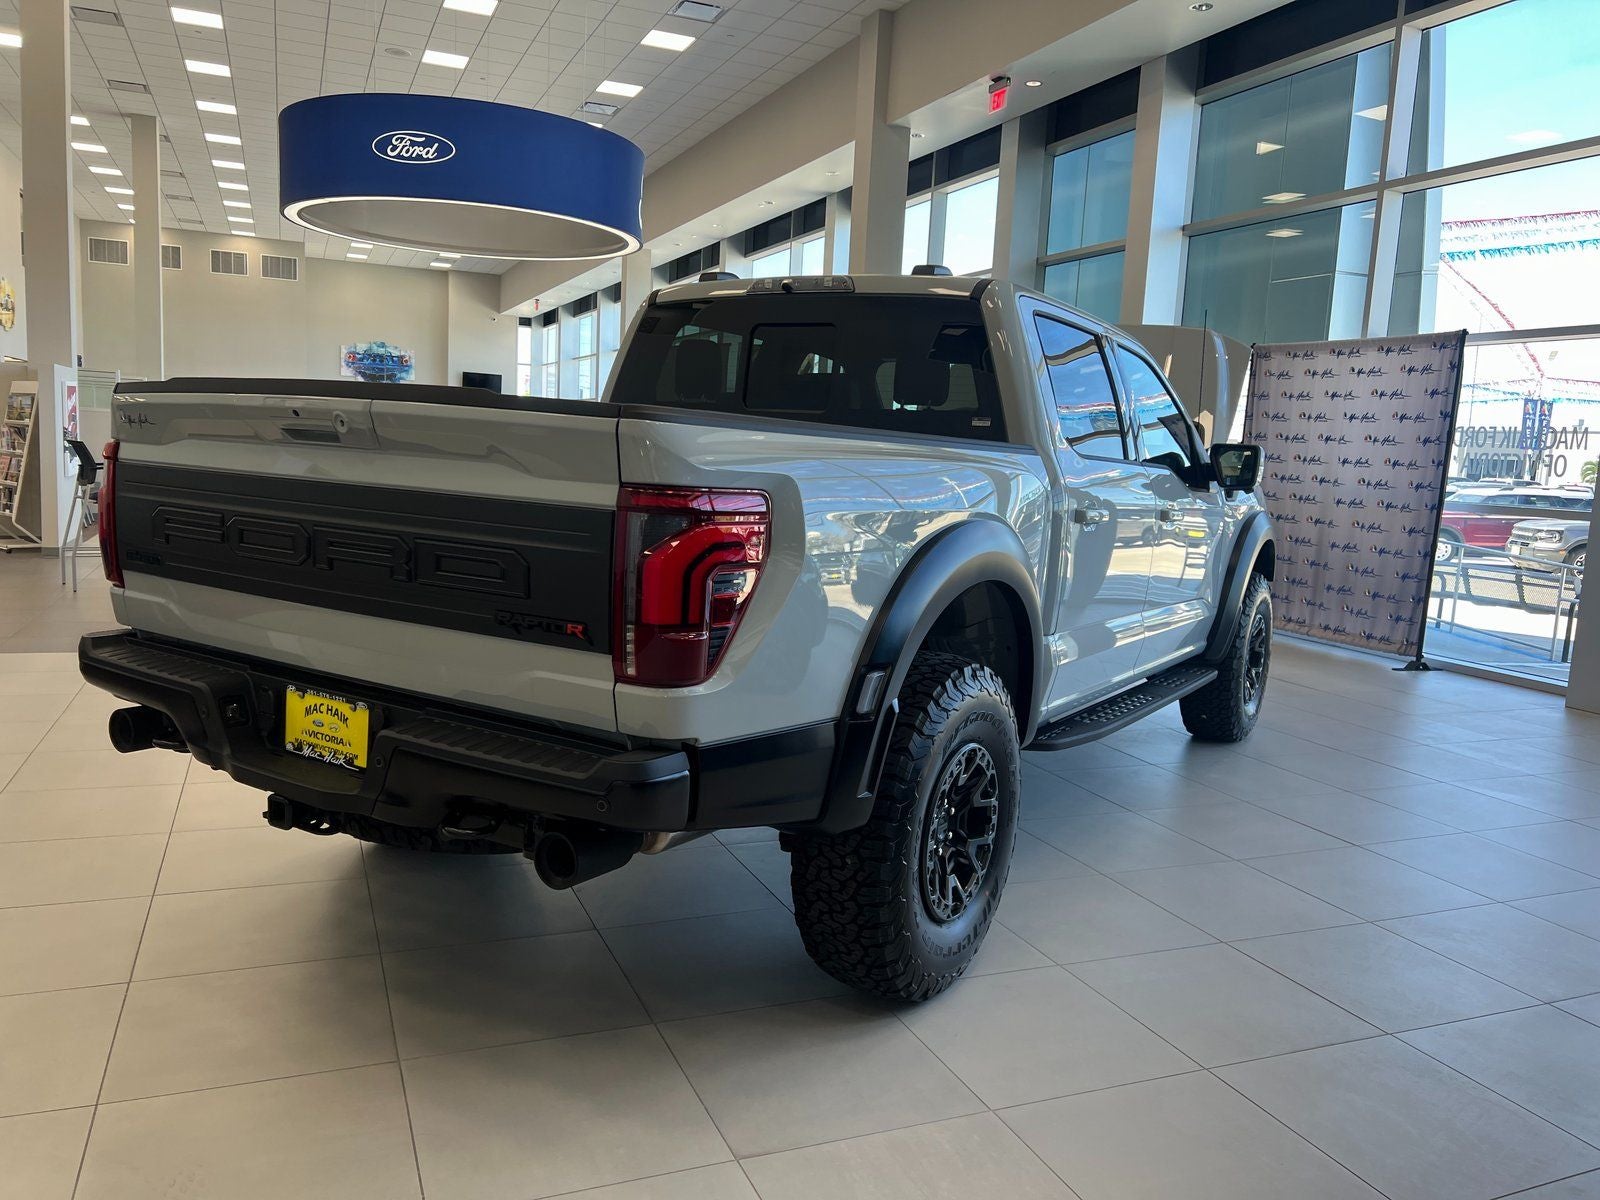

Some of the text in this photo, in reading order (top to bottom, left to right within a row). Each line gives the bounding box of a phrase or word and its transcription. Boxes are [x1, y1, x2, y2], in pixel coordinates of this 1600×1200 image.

[387, 134, 439, 159] Ford
[152, 505, 530, 599] FORD
[495, 609, 592, 646] RAPTOR
[304, 703, 349, 728] MAC HAIK
[308, 730, 345, 747] VICTORIA
[301, 745, 359, 772] Mac Haik
